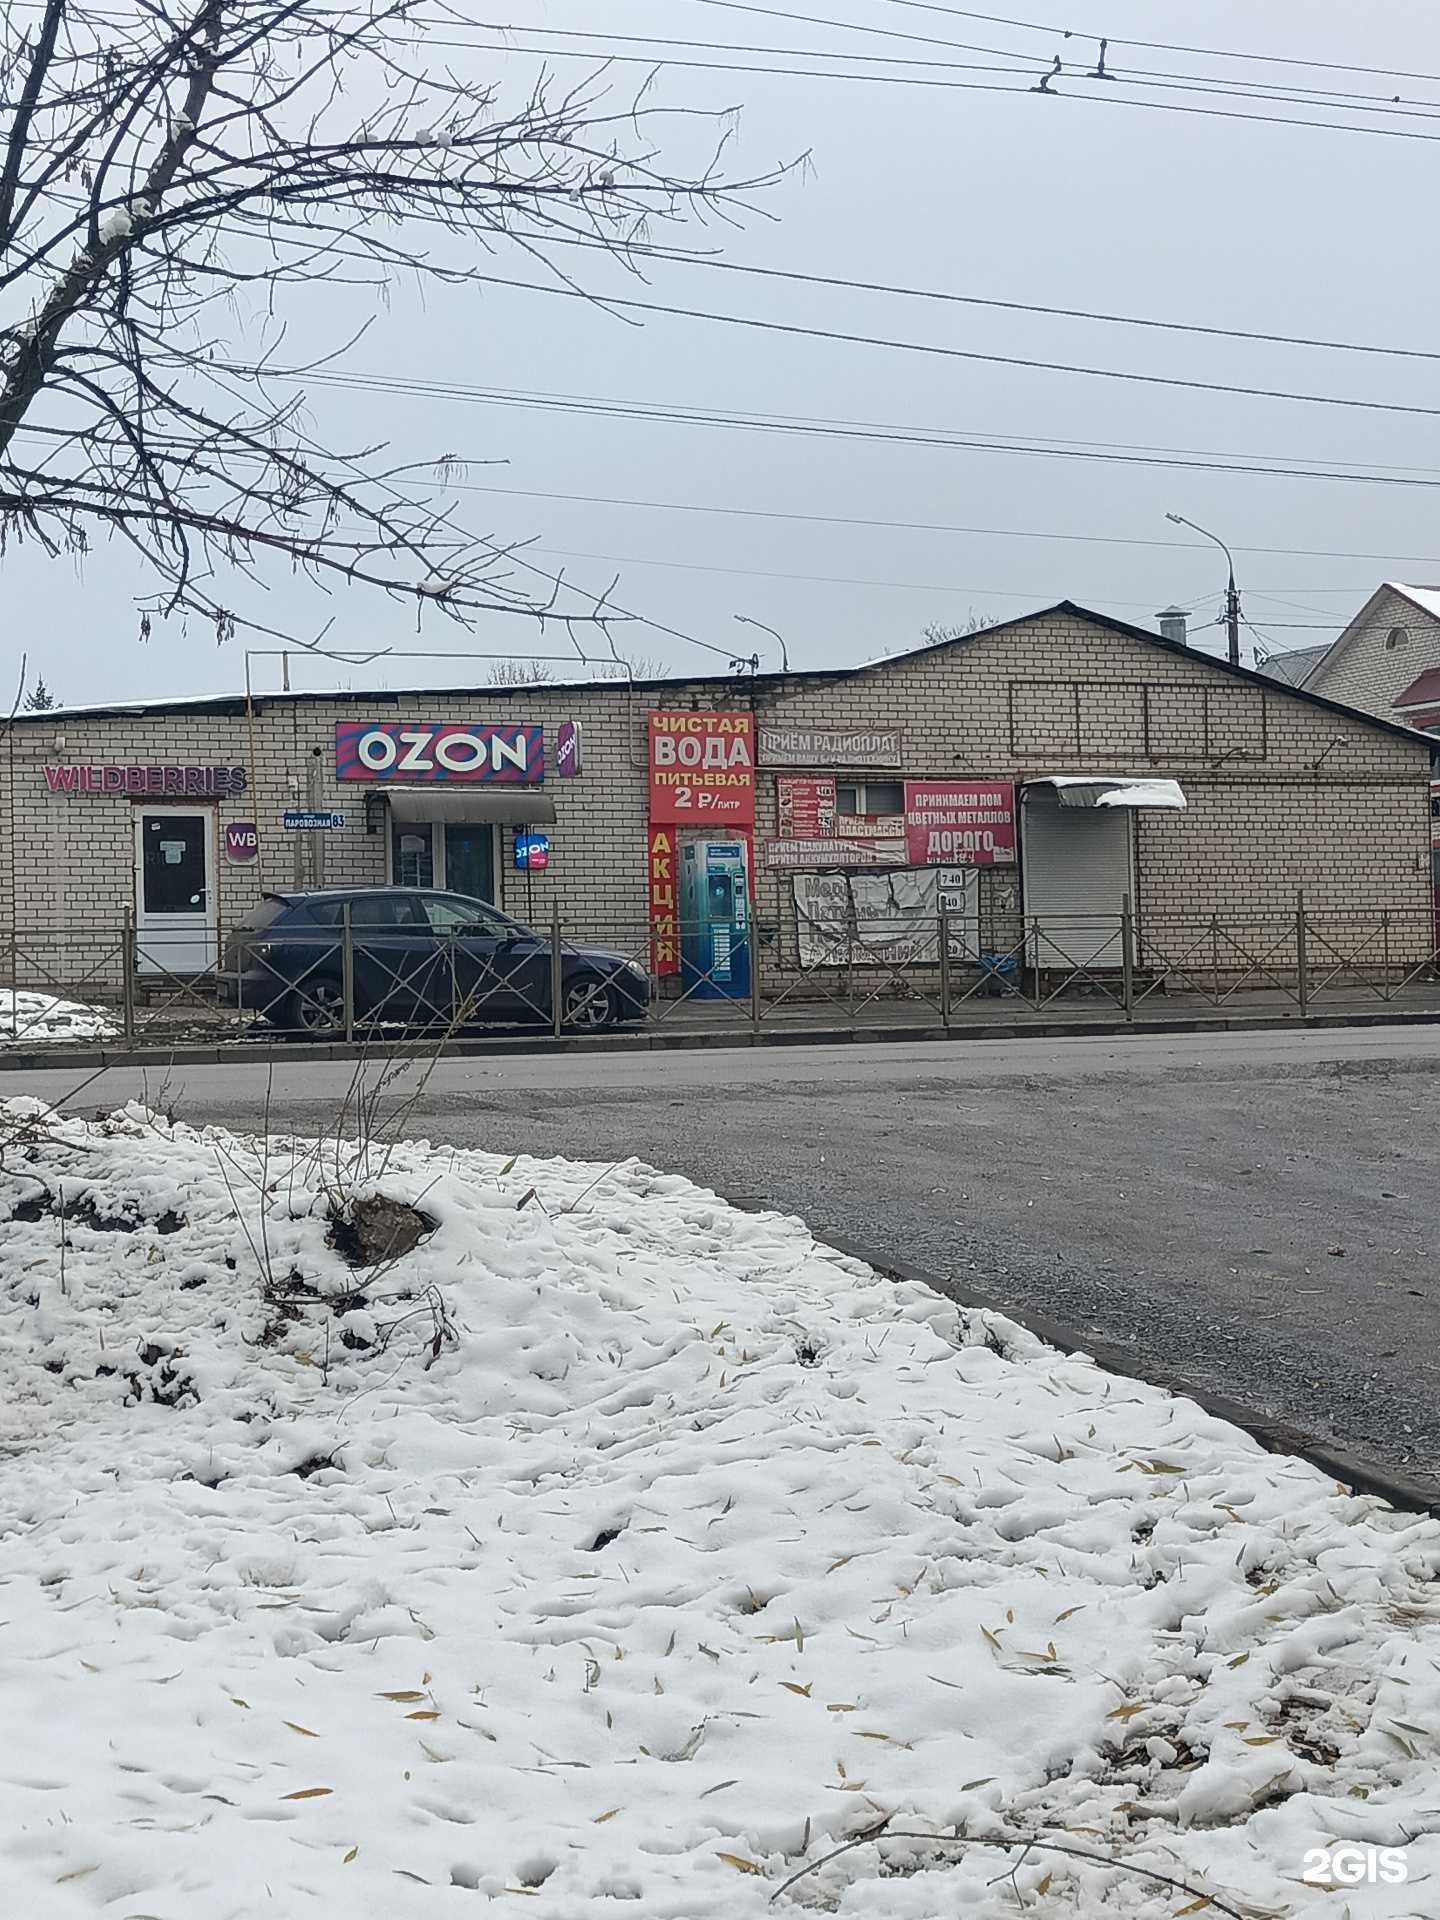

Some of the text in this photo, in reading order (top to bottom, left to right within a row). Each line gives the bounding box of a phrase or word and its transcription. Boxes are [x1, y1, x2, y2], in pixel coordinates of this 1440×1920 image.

[653, 717, 749, 733] ЧИСТАЯ
[358, 731, 528, 772] OZON
[762, 731, 898, 753] ПРИЁМ РАДИОПЛАТ
[655, 736, 751, 769] ВОДА
[43, 766, 248, 793] WILDBERRIES
[655, 773, 750, 785] ПИТЬЕВАЯ
[674, 787, 692, 807] 2
[915, 794, 1003, 806] ПРИНИМАЕМ ЛОМ
[285, 814, 345, 827] ПАРОВОЗНАЯ 83
[908, 811, 1011, 826] ЦВЕТНЫХ МЕТАЛЛОВ
[229, 833, 257, 846] WB
[928, 831, 994, 855] ДОРОГО
[652, 833, 674, 961] АКЦИЯ
